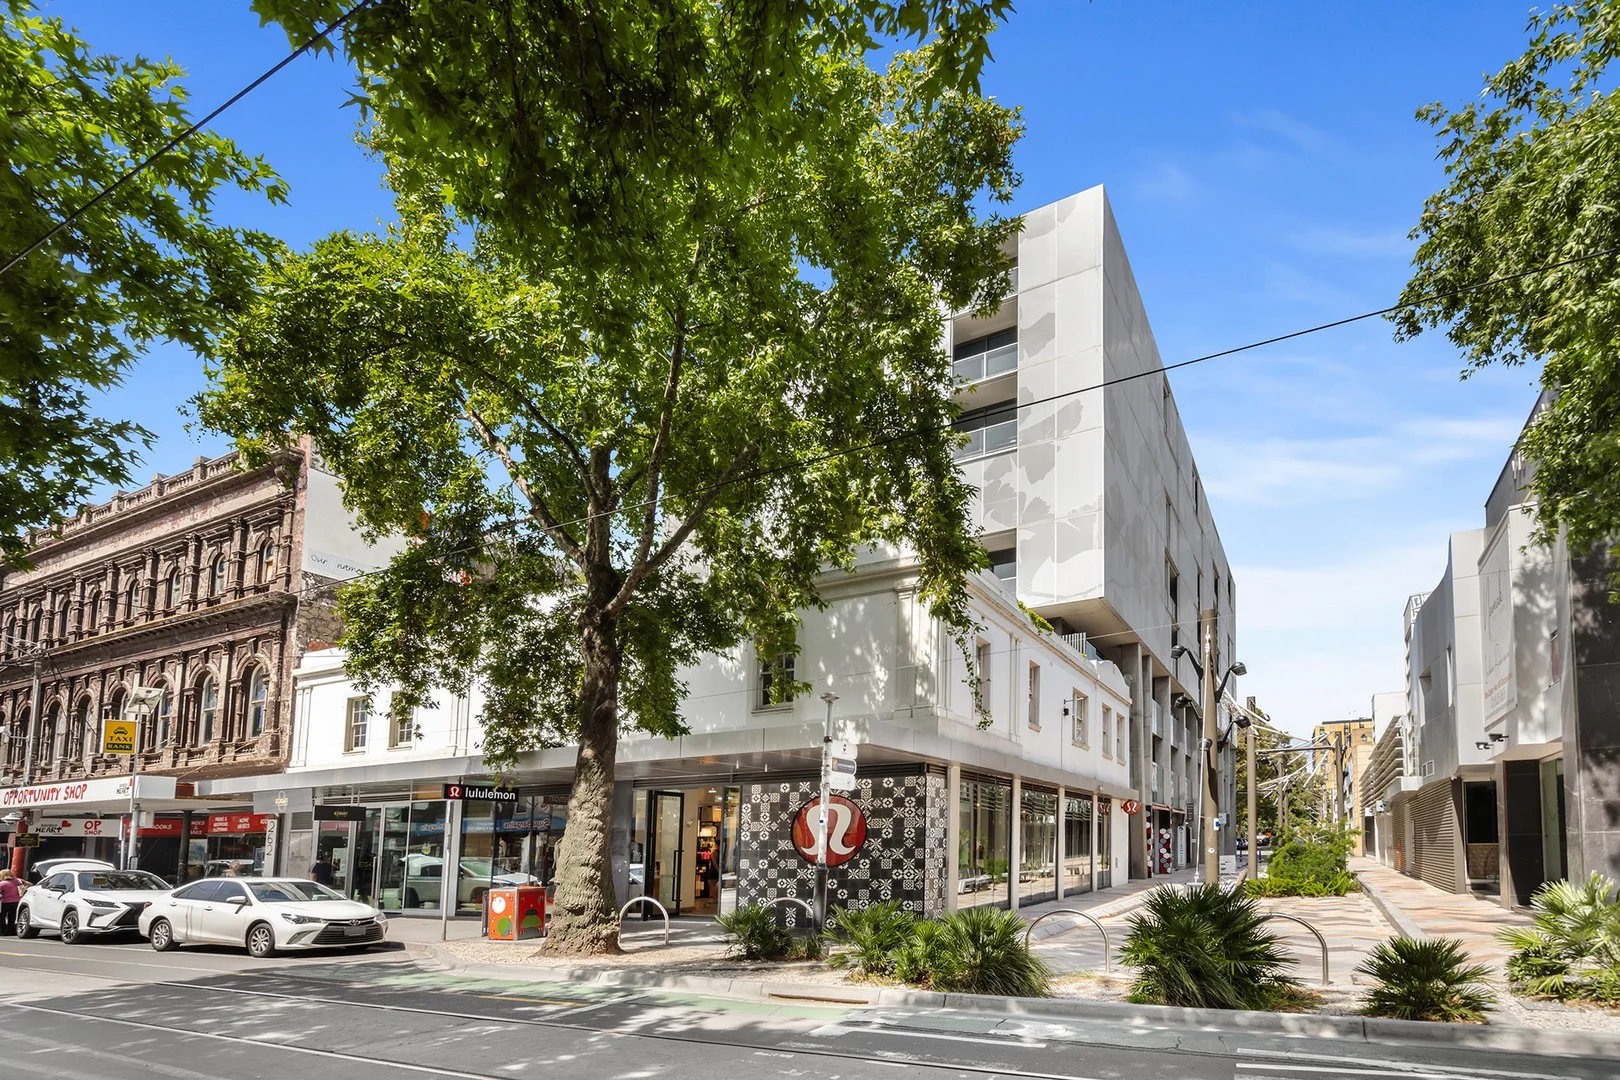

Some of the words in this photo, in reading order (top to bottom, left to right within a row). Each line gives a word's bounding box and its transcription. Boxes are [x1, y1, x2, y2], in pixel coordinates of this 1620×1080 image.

[311, 554, 328, 565] Our
[3, 787, 61, 805] OPPORTUNITY
[63, 784, 88, 801] SHOP
[465, 787, 516, 800] lululemon
[84, 820, 102, 830] OP
[266, 821, 276, 857] 262
